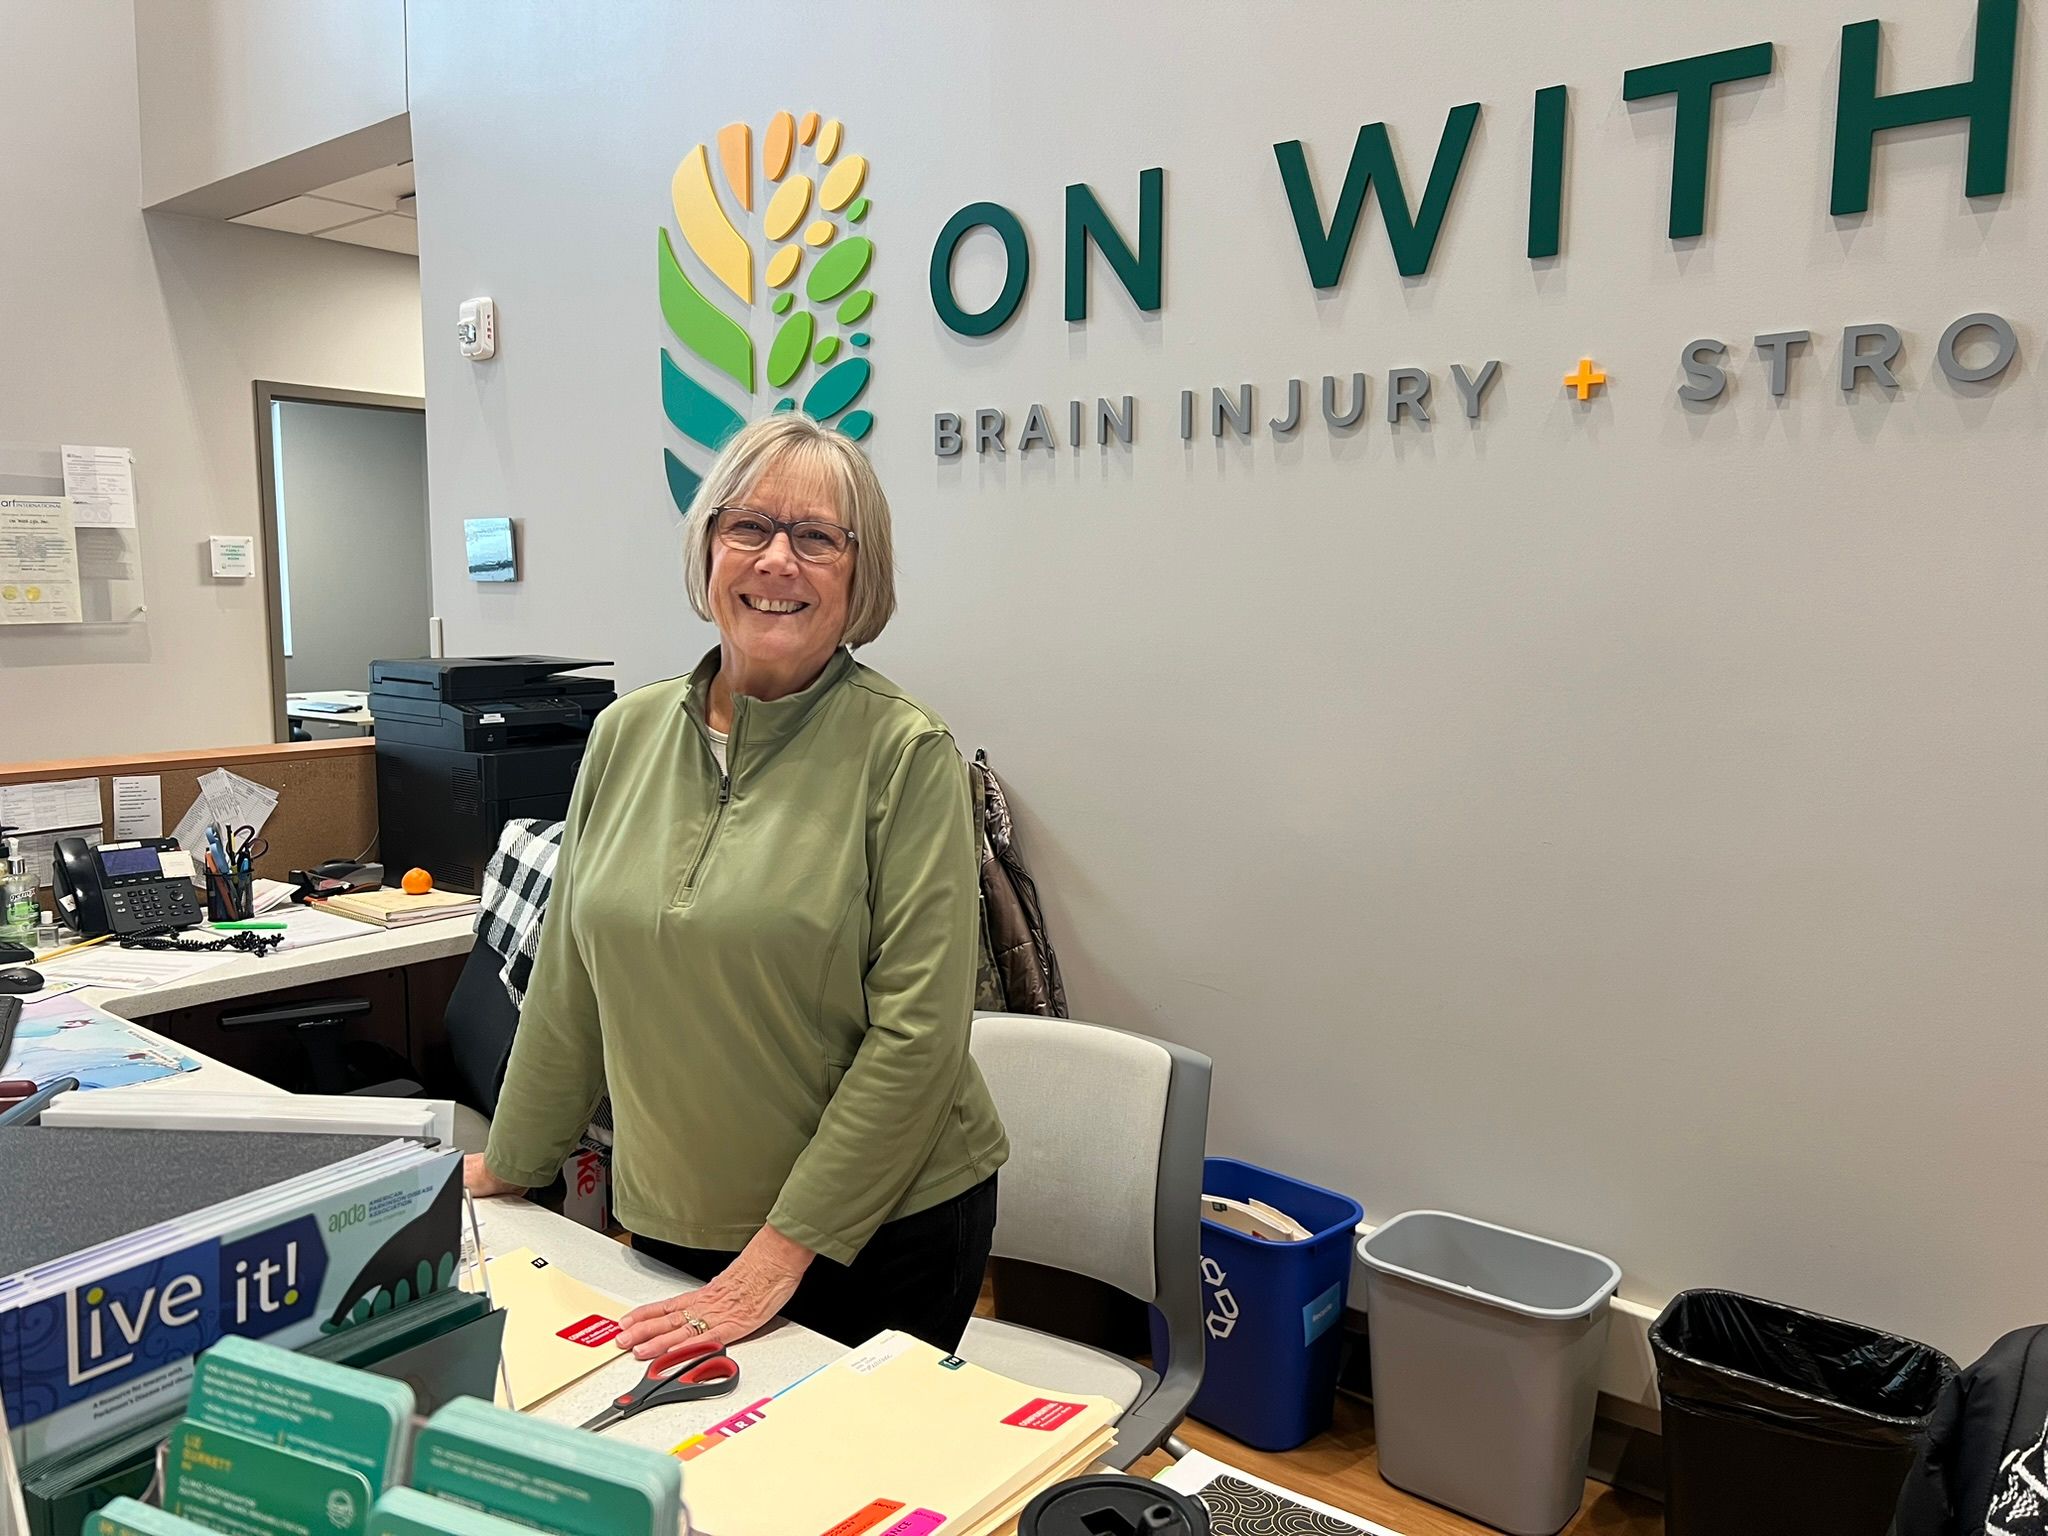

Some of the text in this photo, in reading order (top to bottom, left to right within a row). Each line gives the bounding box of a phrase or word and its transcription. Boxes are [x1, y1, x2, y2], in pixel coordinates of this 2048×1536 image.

[930, 0, 2018, 336] ON WITH
[934, 394, 1133, 456] BRAIN
[1181, 360, 1501, 439] INJURY
[1677, 312, 2018, 401] STRO
[577, 1152, 598, 1200] ke
[368, 1185, 433, 1212] PARKINSON DISEASE
[369, 1191, 403, 1206] AMERICAN
[369, 1200, 412, 1218] ASSOCIATION
[328, 1203, 366, 1232] apda
[66, 1241, 299, 1387] Live it!
[567, 1319, 611, 1340] CONFIDENTIAL
[93, 1399, 134, 1419] Parkinson's
[1018, 1402, 1059, 1426] CONFIDENTIAL
